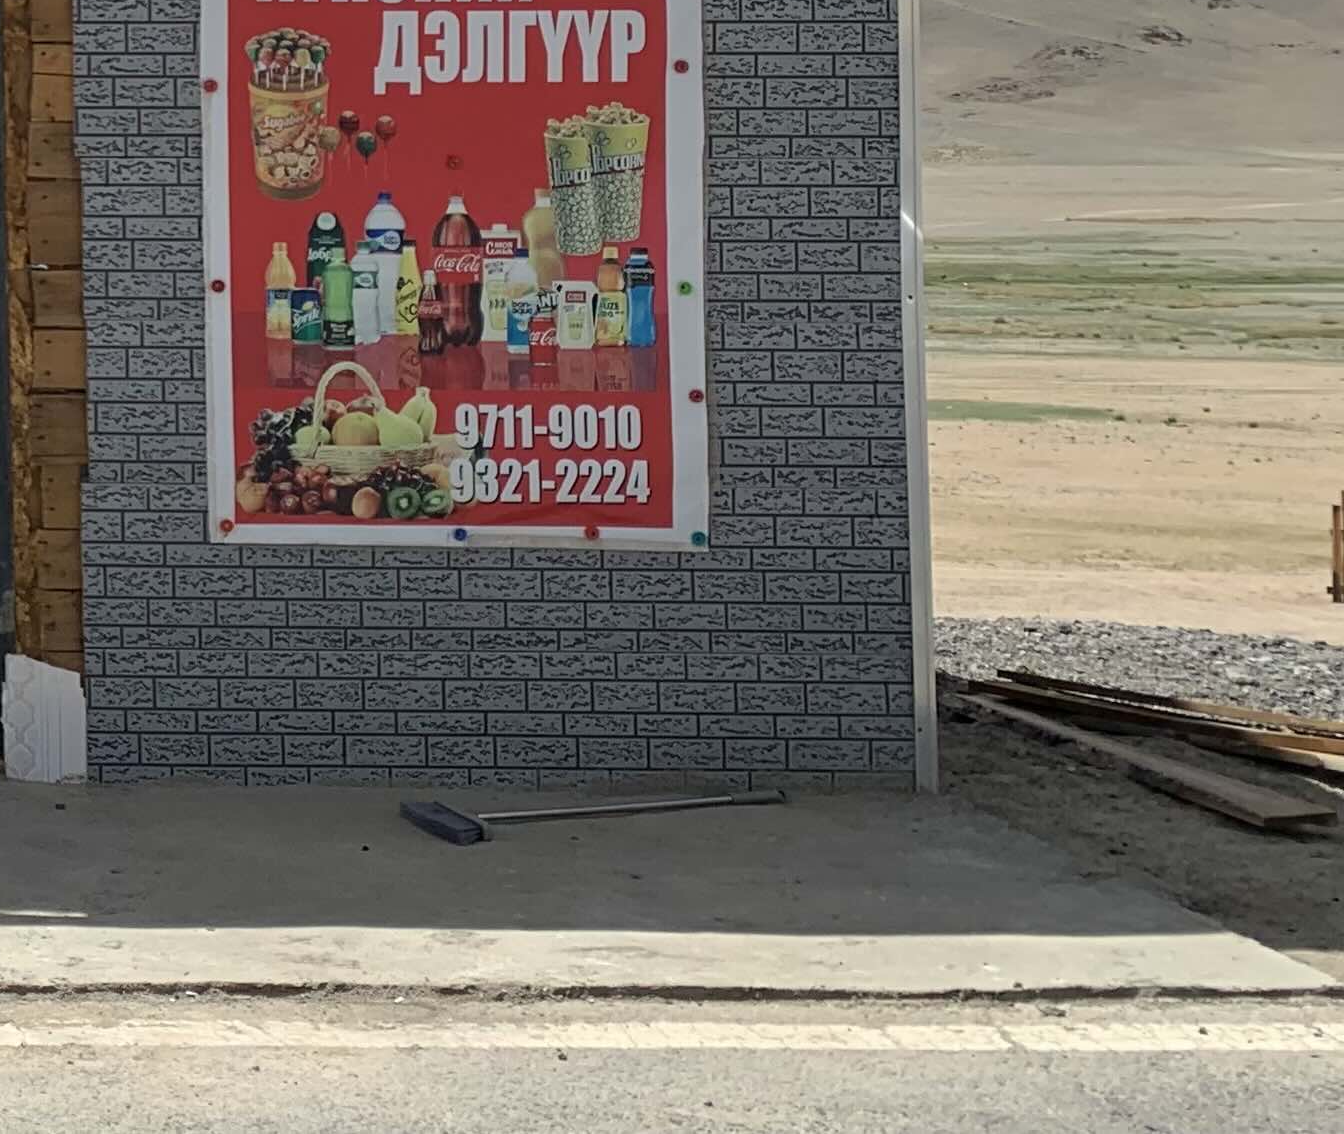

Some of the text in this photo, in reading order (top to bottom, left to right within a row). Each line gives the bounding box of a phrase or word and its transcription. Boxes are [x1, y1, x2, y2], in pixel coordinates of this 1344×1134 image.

[373, 9, 647, 96] ДЭЛГҮҮР
[551, 157, 591, 185] POPCO
[454, 403, 643, 450] 9711-9010
[448, 458, 652, 504] 9321-2224
